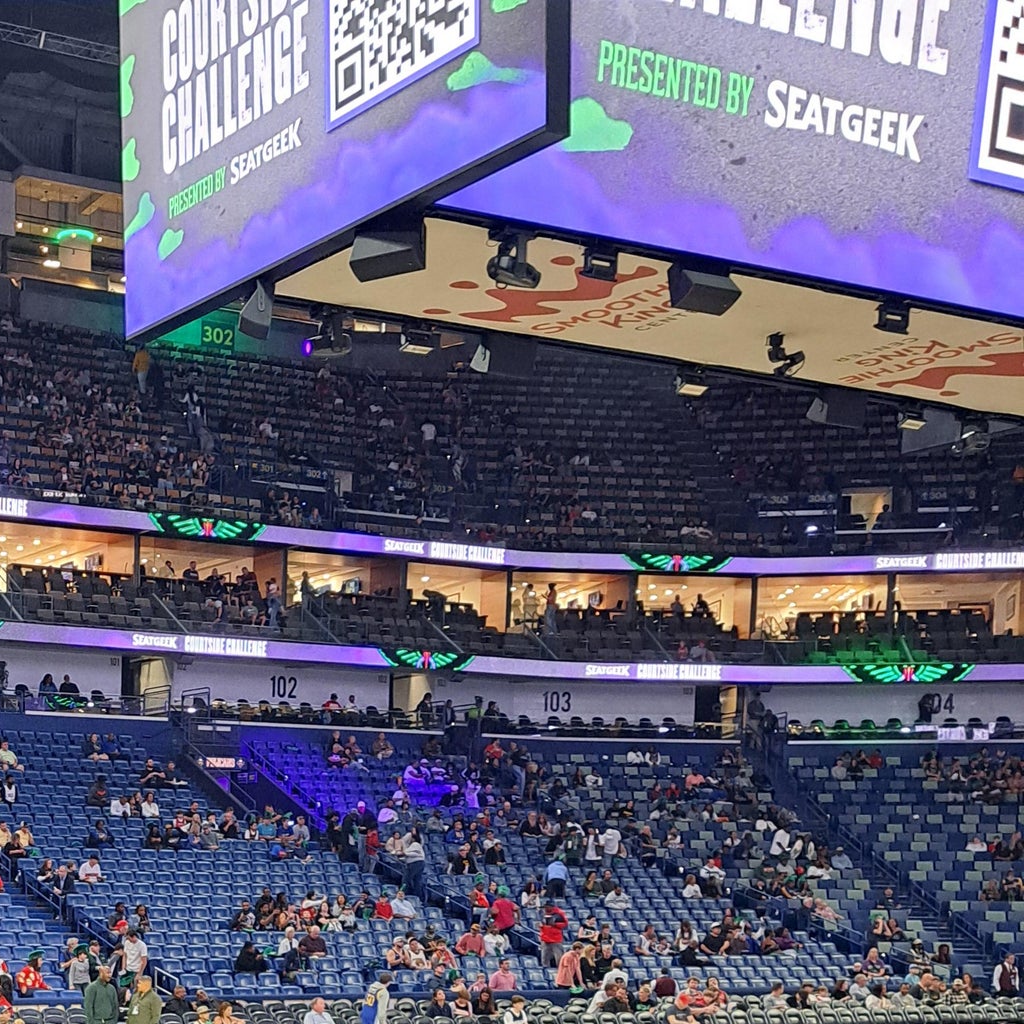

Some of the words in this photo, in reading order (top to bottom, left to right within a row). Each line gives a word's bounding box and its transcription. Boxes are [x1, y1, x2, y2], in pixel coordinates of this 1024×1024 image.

[163, 0, 309, 92] COURT
[162, 4, 310, 175] CHALLENGE
[597, 39, 722, 110] PRESENTED
[725, 71, 754, 117] BY
[764, 79, 925, 163] SEATGEEK
[168, 174, 214, 219] PRESENTED
[214, 166, 226, 193] BY
[230, 117, 303, 185] SEATGEEK
[531, 281, 669, 334] SMOOTH
[202, 325, 234, 346] 302
[836, 337, 919, 363] CENTER
[839, 332, 1022, 384] SMOOTHIE
[384, 539, 424, 555] SEATGEEK
[876, 556, 927, 569] SEATGEEK
[984, 551, 1024, 568] CHALLEN
[132, 633, 177, 649] SEATGEEK
[184, 635, 225, 654] COURTSIDE
[226, 638, 267, 657] CHALLENGE
[585, 664, 630, 677] SEATGEEK
[637, 663, 679, 680] COURTSIDE
[679, 663, 722, 681] CHALLENGE
[270, 674, 297, 699] 102
[542, 691, 572, 713] 103
[929, 693, 955, 715] 04
